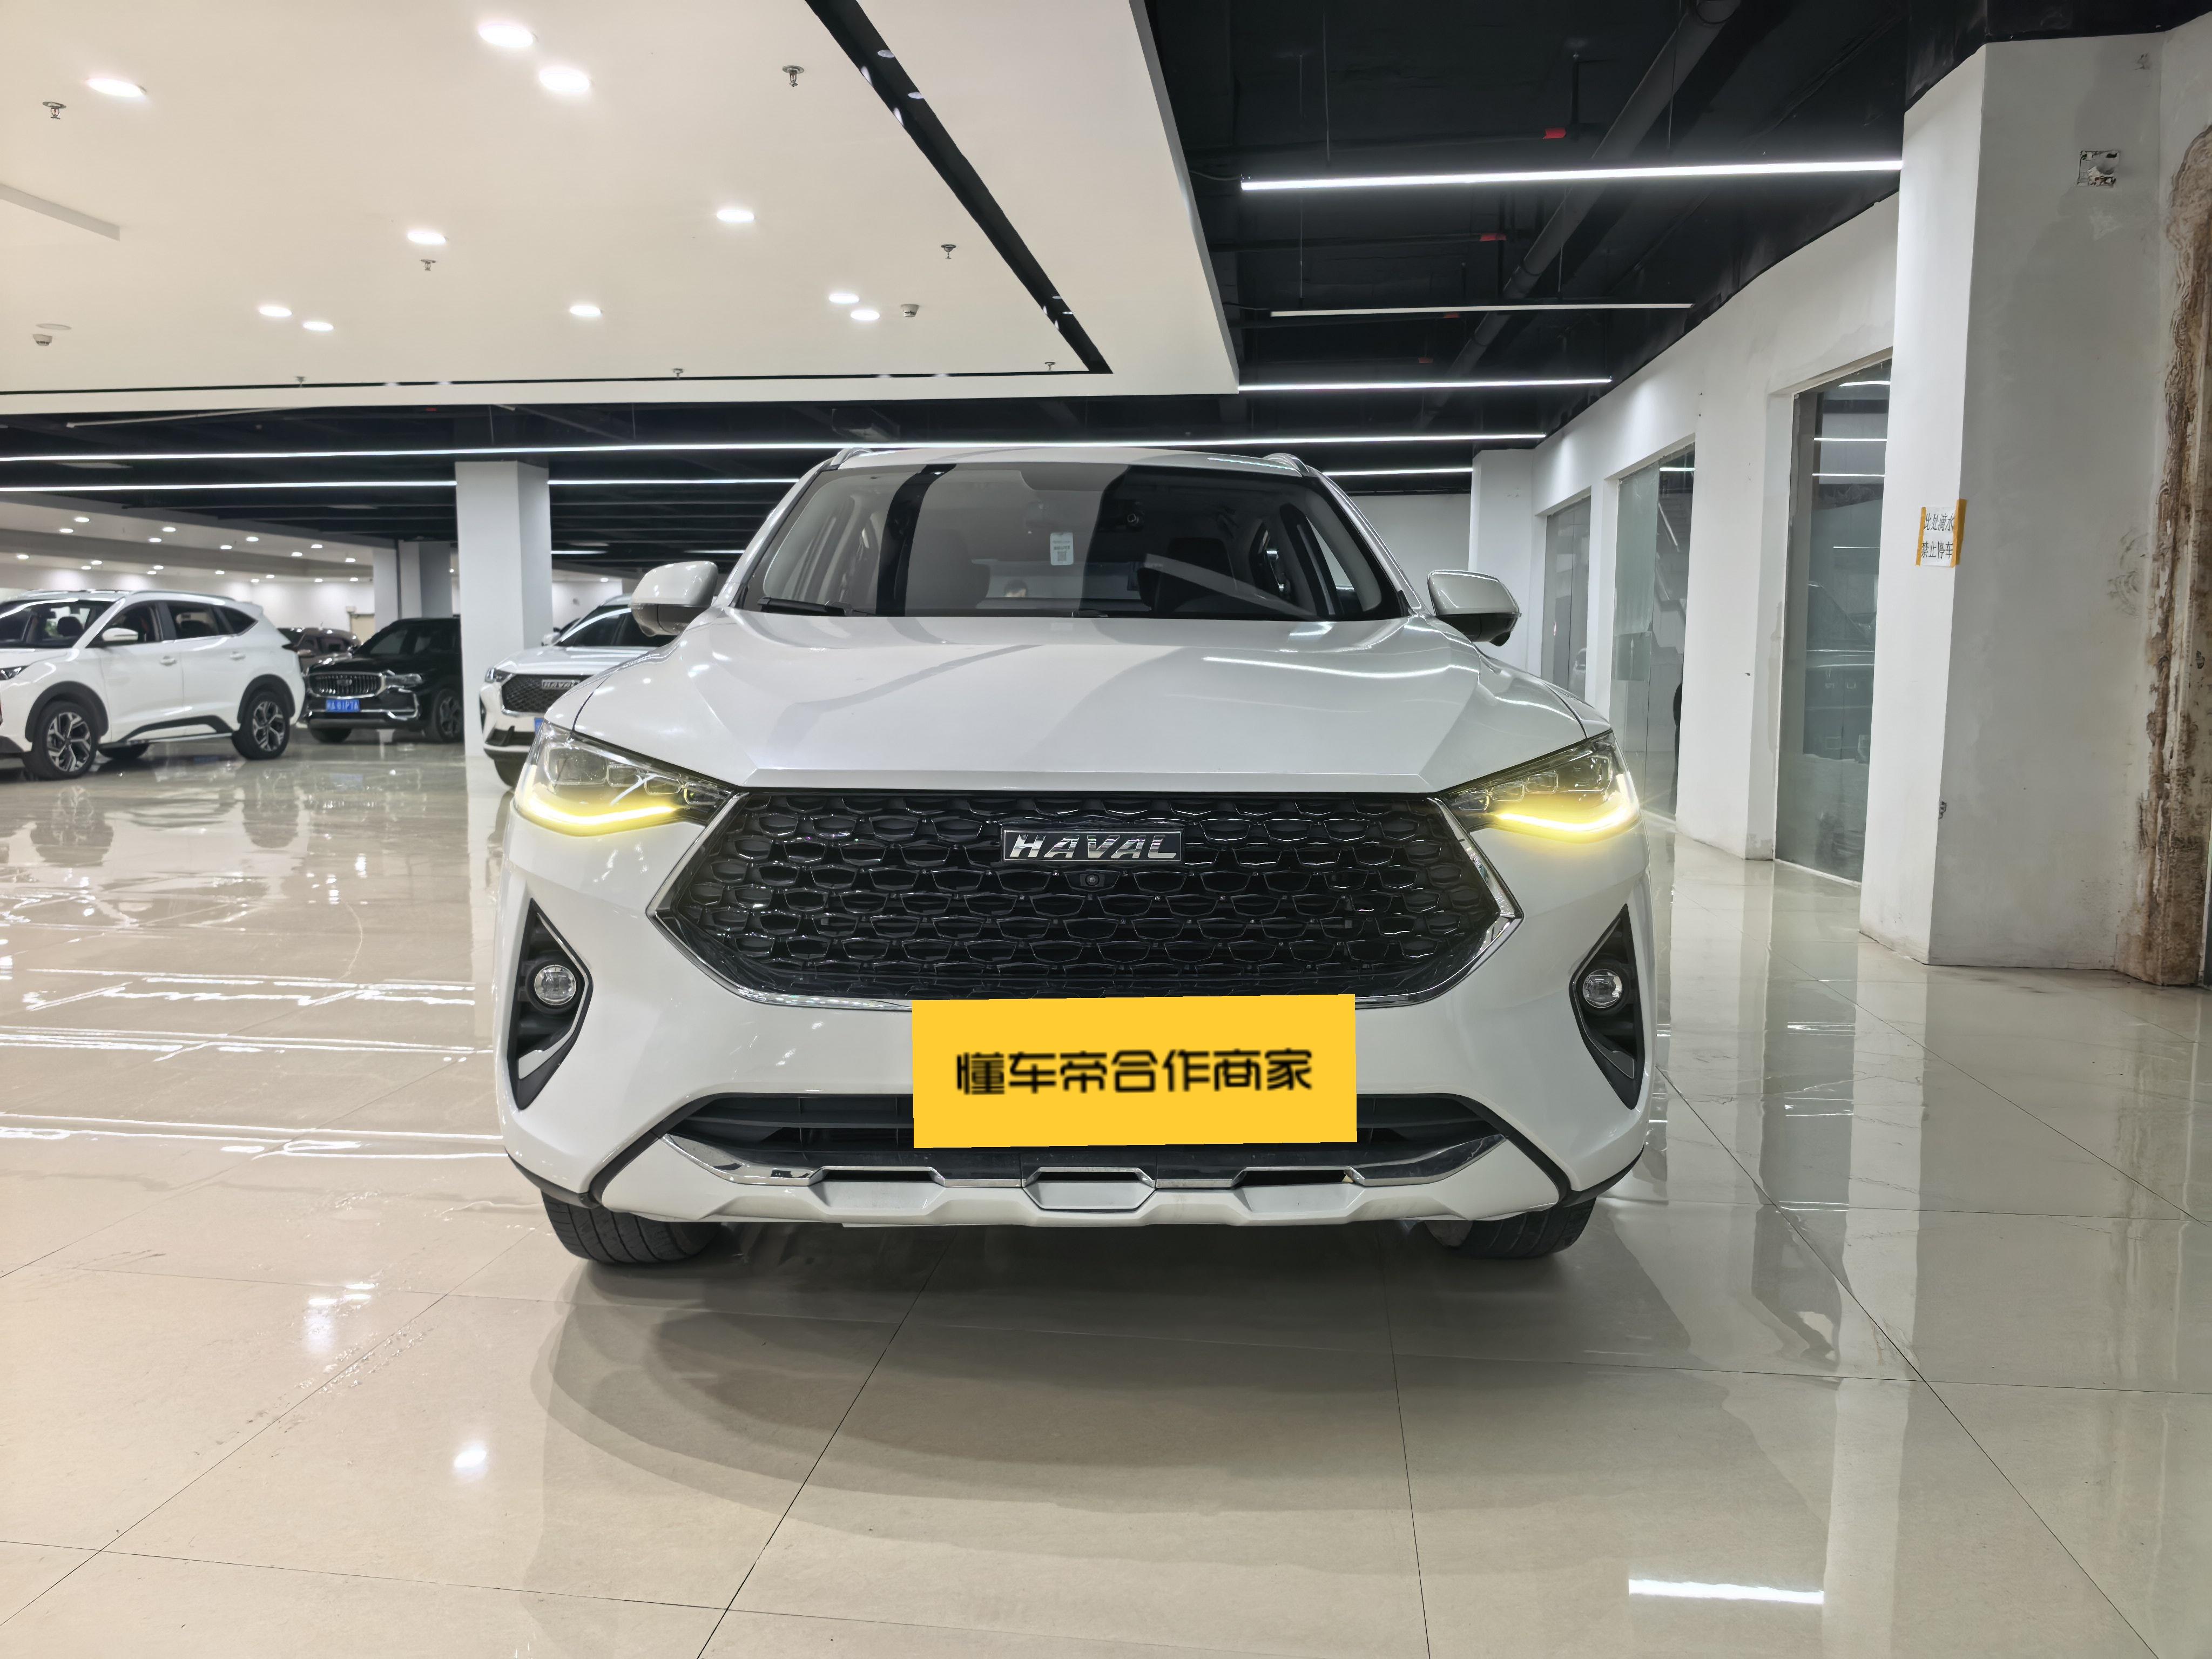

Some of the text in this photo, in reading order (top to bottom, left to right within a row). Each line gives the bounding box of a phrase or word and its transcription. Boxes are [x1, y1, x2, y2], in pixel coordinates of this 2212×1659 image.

[1921, 541, 1953, 559] 禁止停车
[1010, 834, 1177, 858] HAVAL
